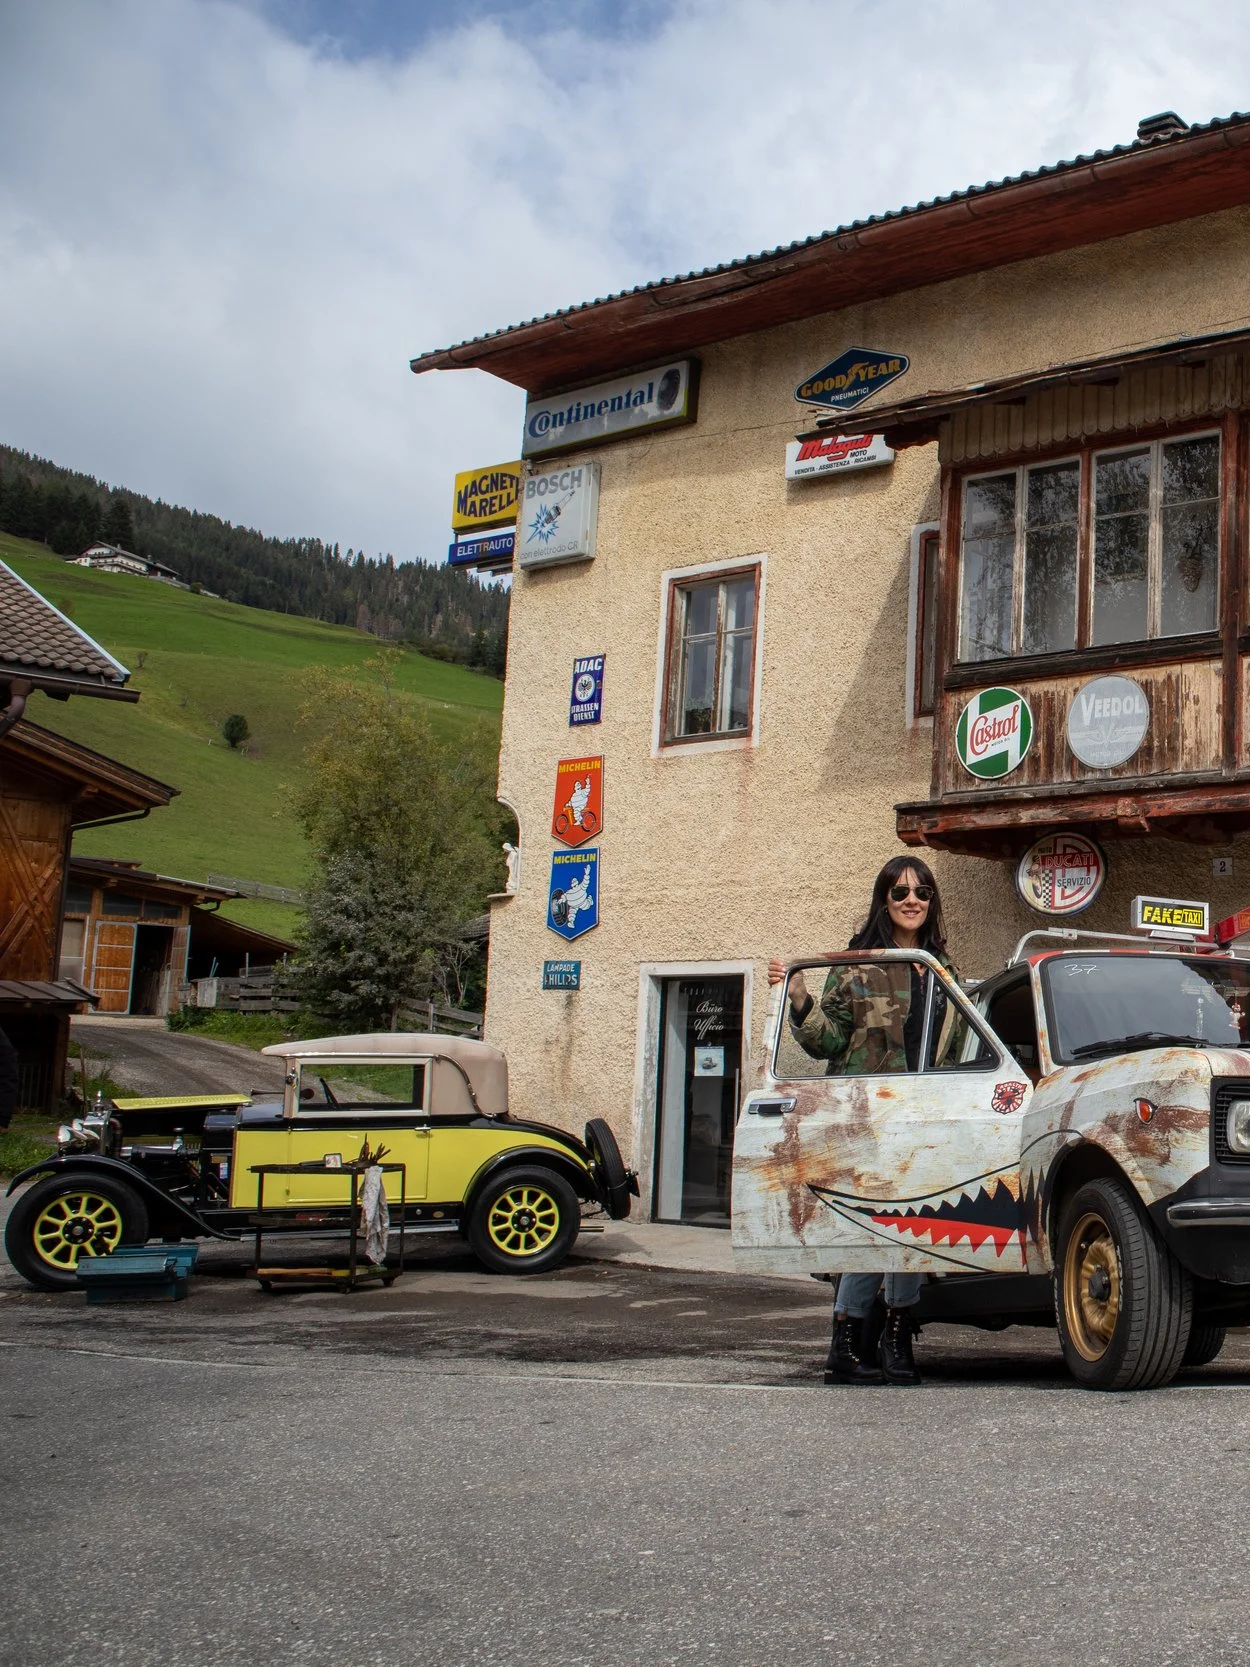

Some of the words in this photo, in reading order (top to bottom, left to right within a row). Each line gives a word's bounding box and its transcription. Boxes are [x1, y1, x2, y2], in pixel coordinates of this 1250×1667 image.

[830, 386, 870, 403] PNEUMATICI
[528, 382, 654, 438] Continental
[849, 449, 868, 458] MOTO
[794, 466, 816, 475] VENDITA
[818, 460, 851, 471] ASSISTENZA
[854, 455, 877, 464] RICAMBI
[525, 469, 583, 500] BOSCH
[457, 537, 514, 557] ELETTRAUTO
[574, 658, 603, 674] ADAC
[573, 711, 595, 721] DIENST
[1080, 693, 1144, 726] VEEDOL
[970, 704, 1020, 756] Castrol
[558, 760, 601, 774] MICHELIN
[553, 853, 597, 865] MICHELIN
[1045, 853, 1094, 869] DUCATI
[1219, 861, 1226, 873] 2
[1057, 876, 1091, 887] SERVIZIO
[1143, 906, 1182, 925] FAKE
[1184, 911, 1201, 924] TAXI
[547, 963, 576, 973] LAMPADE
[1064, 963, 1102, 976] 37
[693, 1015, 724, 1040] Ufficio
